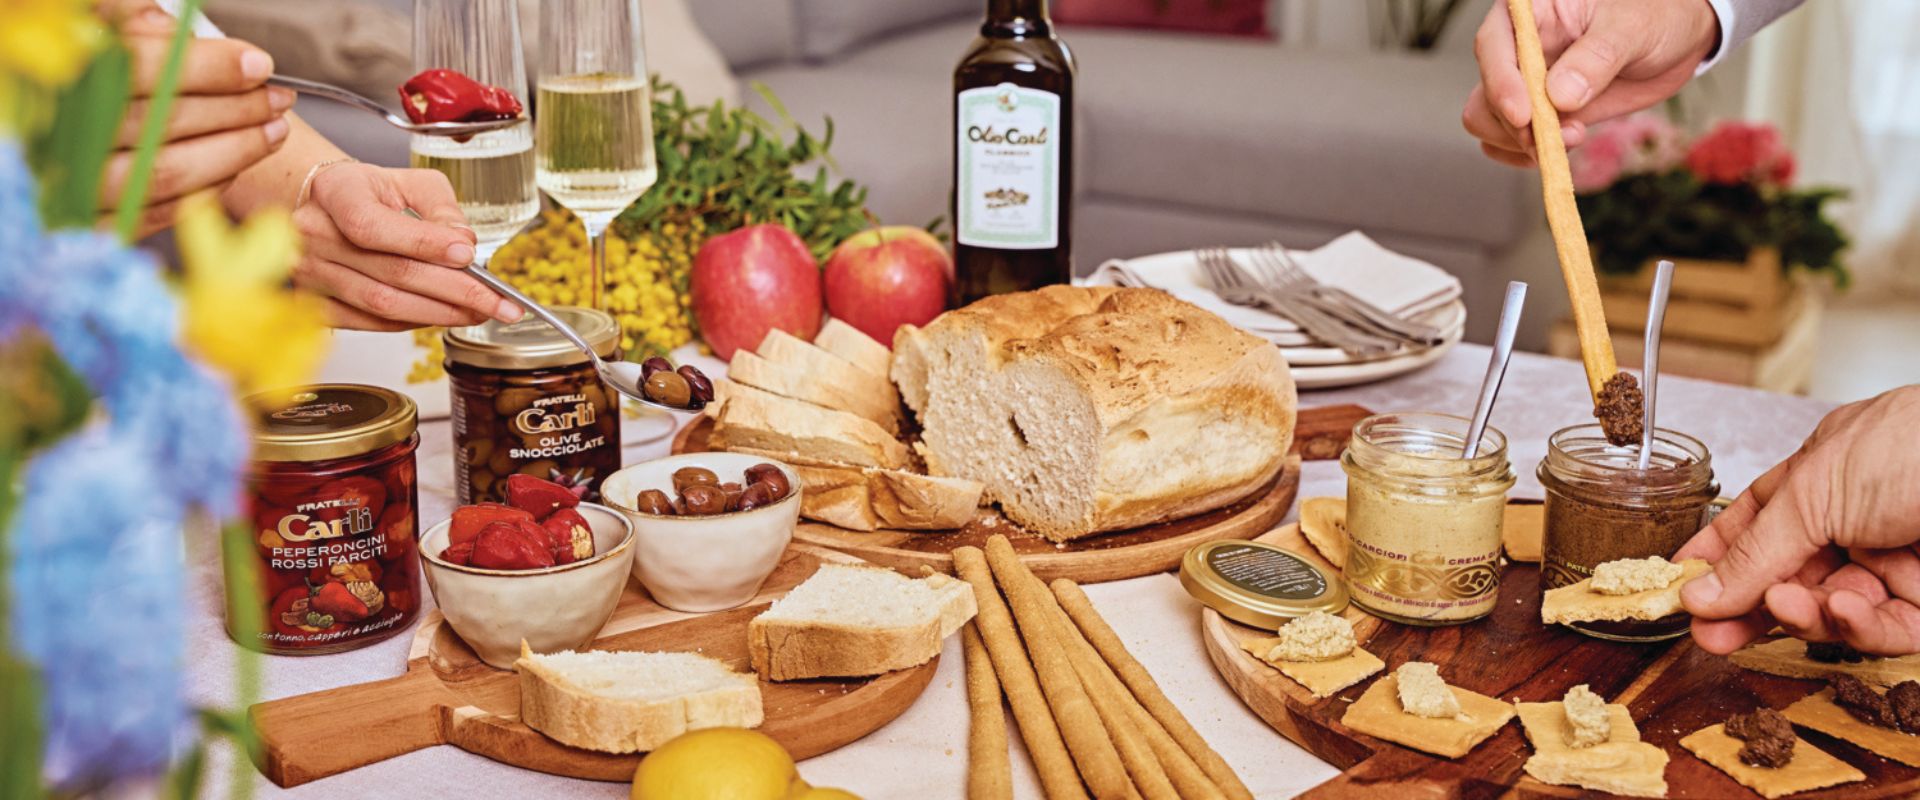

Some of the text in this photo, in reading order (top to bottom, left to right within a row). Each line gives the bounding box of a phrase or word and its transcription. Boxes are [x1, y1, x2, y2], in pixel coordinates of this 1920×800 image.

[533, 394, 586, 408] FRATELLI
[516, 402, 596, 434] Carli
[509, 436, 605, 459] SNOCCIOLATE
[539, 433, 581, 447] OLIVE
[297, 498, 361, 513] FRATELLI
[277, 507, 374, 542] Carli
[272, 533, 386, 558] PEPERONCINI
[1356, 540, 1408, 561] CARCIOFI
[272, 544, 388, 569] ROSSI FARCITI
[1448, 554, 1486, 566] CREMA
[256, 632, 274, 640] con
[307, 627, 352, 641] capperi
